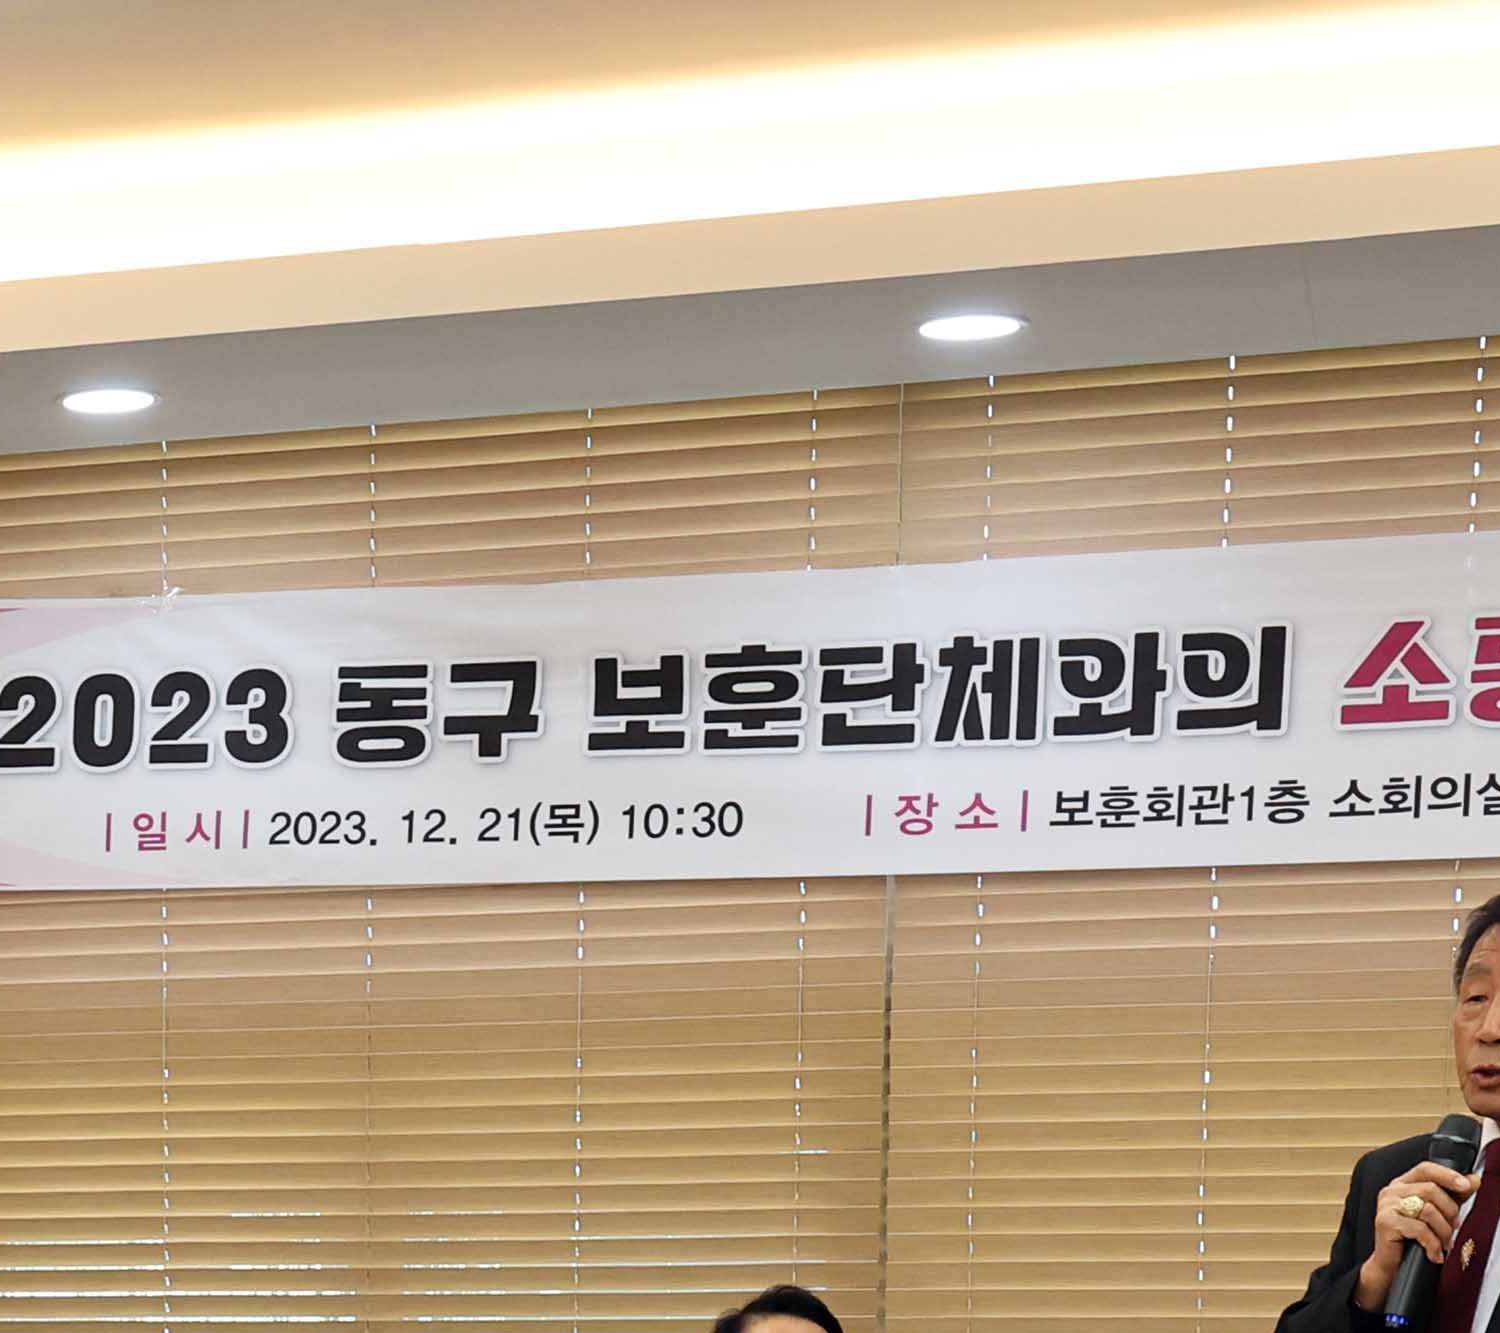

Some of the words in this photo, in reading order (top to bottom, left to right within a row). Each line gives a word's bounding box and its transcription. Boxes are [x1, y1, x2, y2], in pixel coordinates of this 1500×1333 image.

[334, 660, 540, 764] 동구
[590, 626, 1286, 752] 보훈단체와의
[479, 800, 600, 846] 21(목)
[621, 800, 742, 840] 10:30
[1049, 781, 1310, 829] 보훈회관1층
